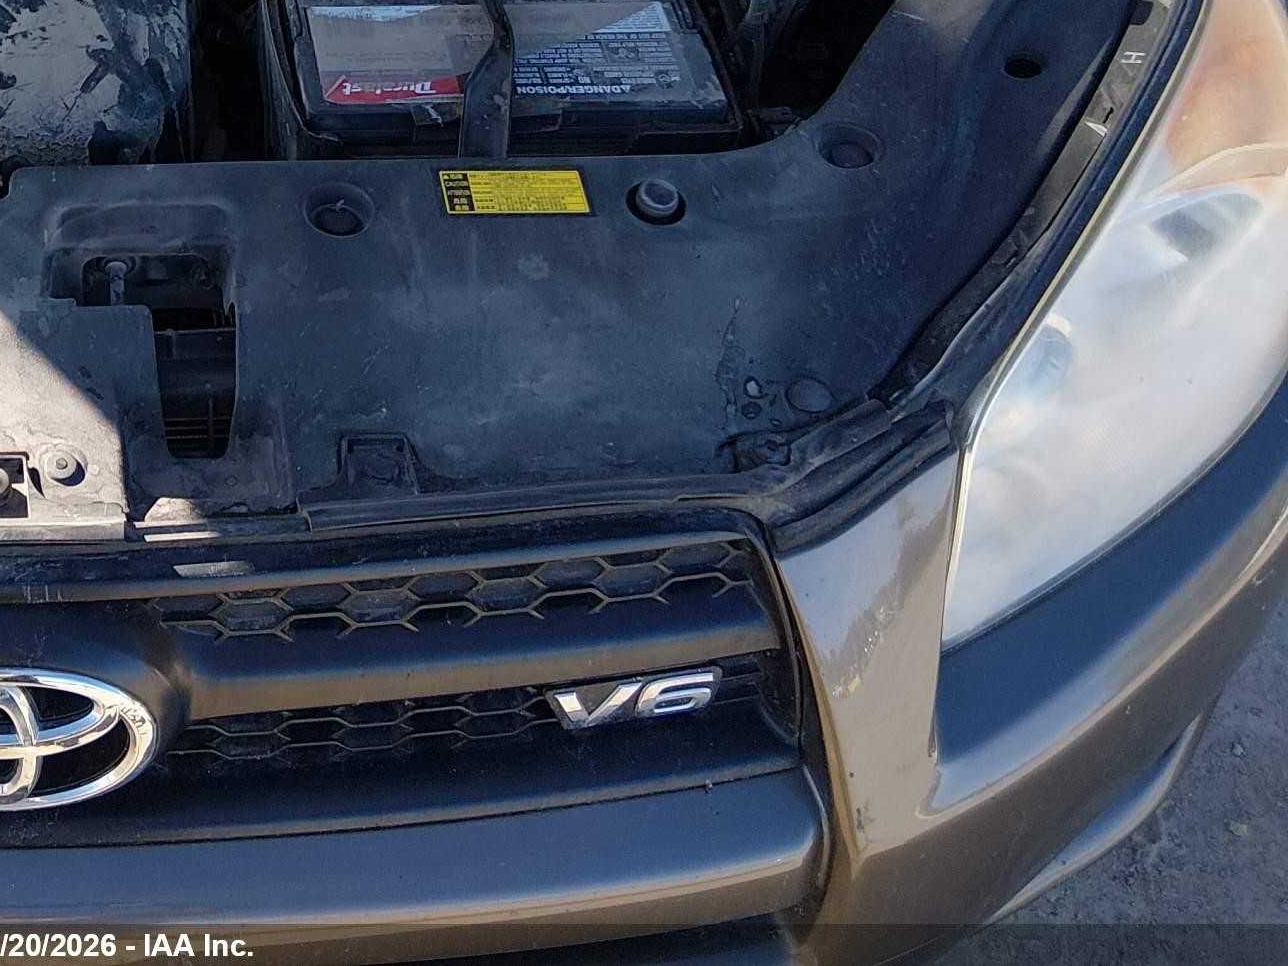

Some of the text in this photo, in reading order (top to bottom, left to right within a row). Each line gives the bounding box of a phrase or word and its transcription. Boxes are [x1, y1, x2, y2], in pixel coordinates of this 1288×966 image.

[342, 81, 436, 95] Duralast
[516, 85, 621, 95] DANGER/POISON
[553, 670, 715, 727] V6
